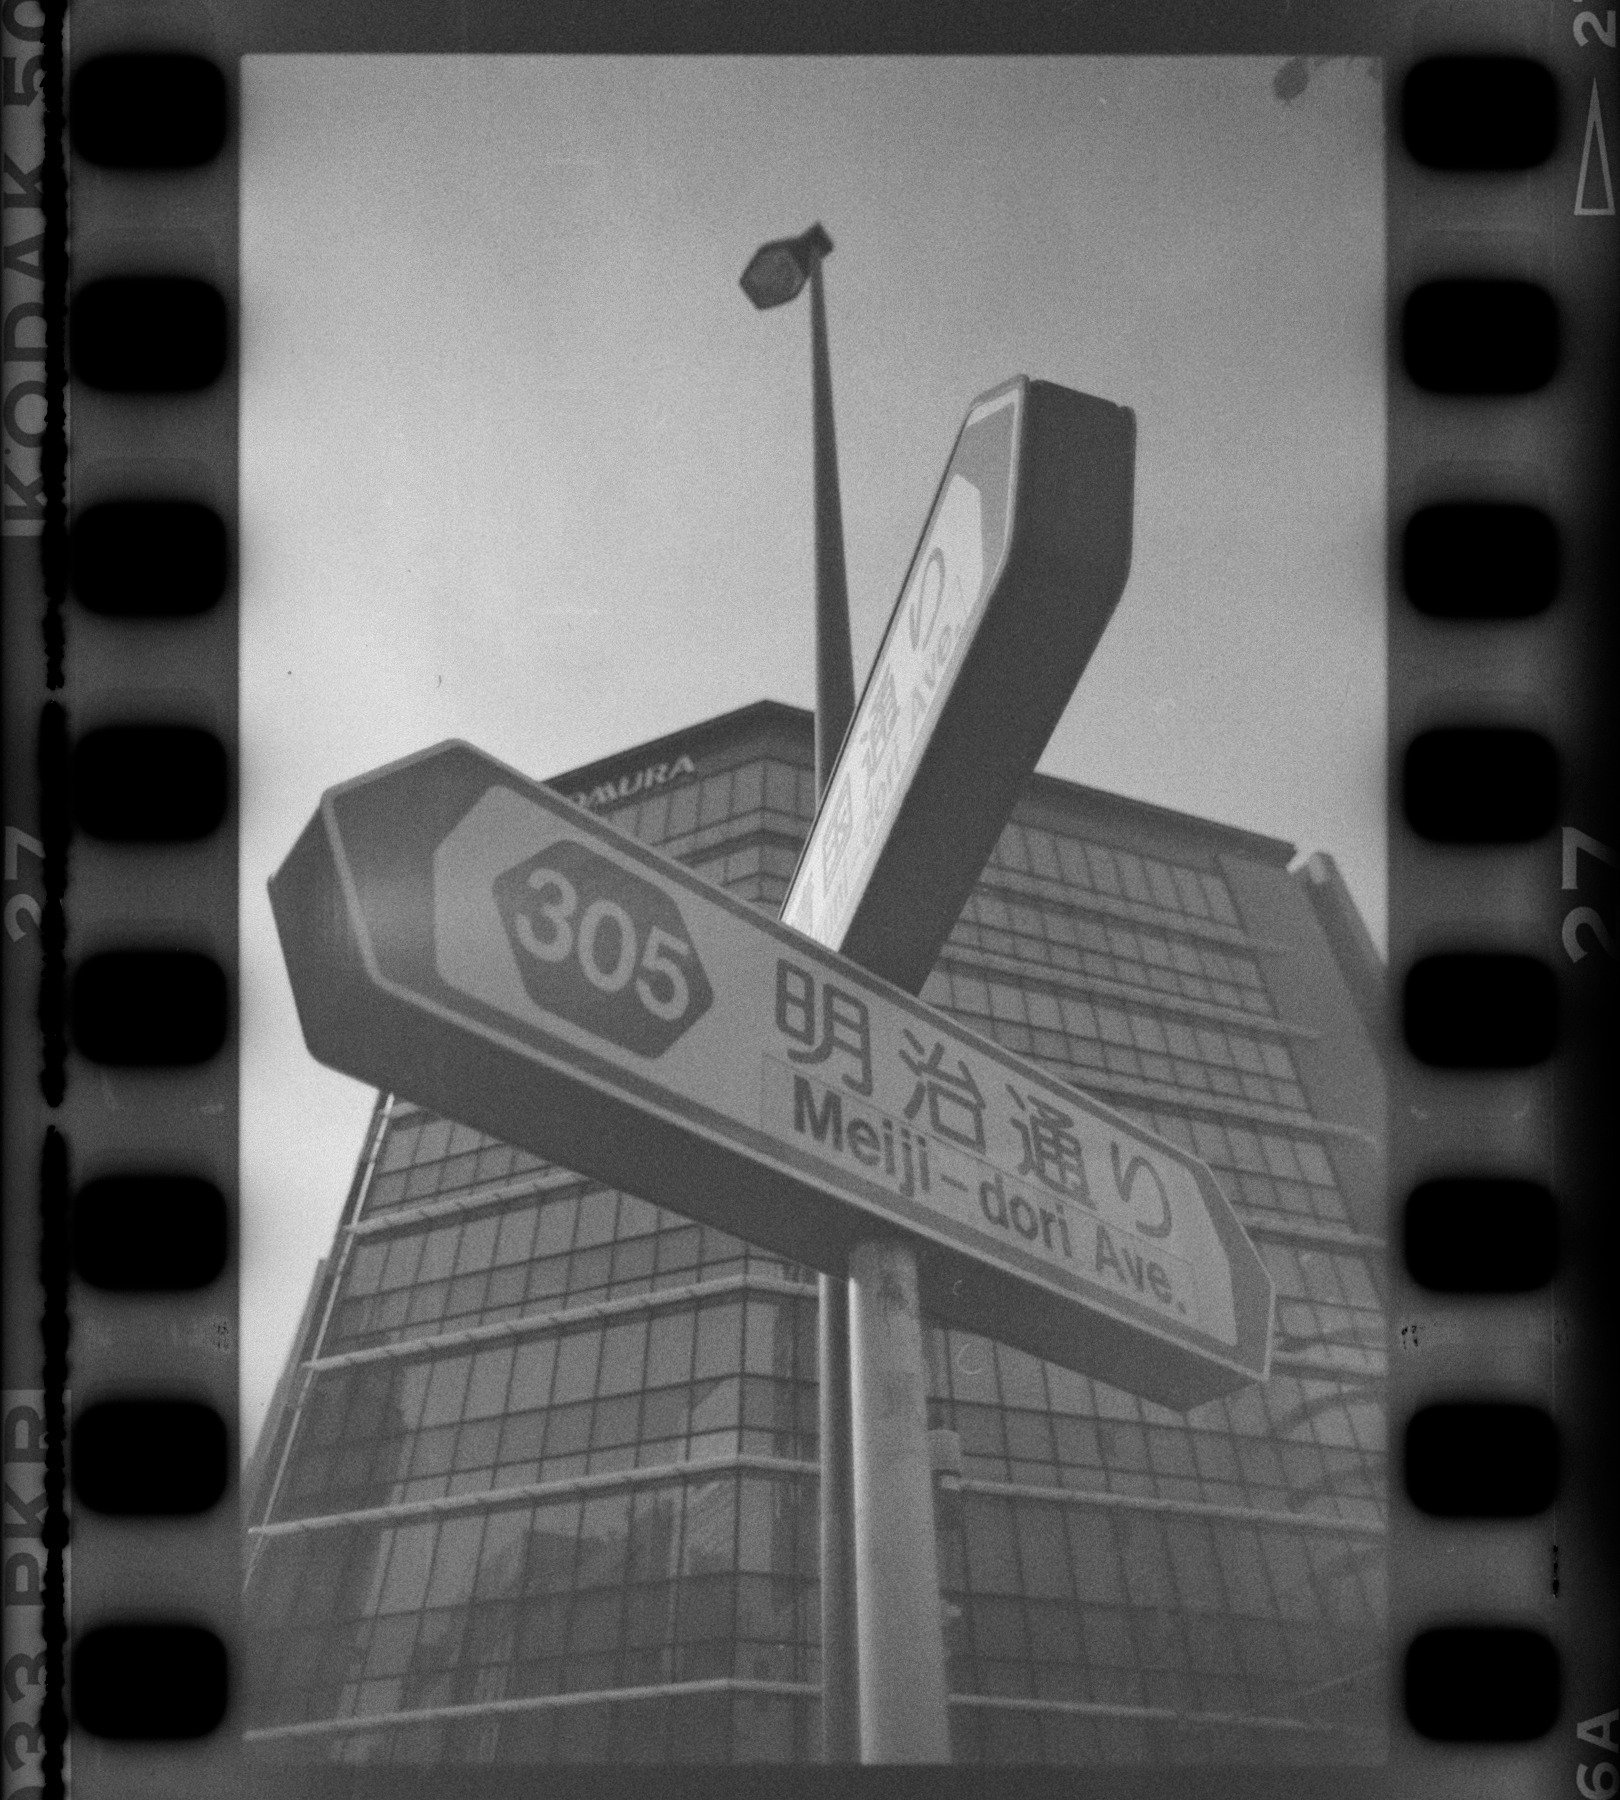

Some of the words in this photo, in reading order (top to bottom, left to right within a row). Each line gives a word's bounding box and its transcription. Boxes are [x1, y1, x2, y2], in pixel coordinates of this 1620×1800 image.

[3, 151, 46, 522] KODAK
[4, 826, 46, 943] 27
[512, 867, 690, 1022] 305
[1561, 827, 1618, 963] 27
[775, 957, 1173, 1239] 明治通り
[793, 1073, 1073, 1259] Meiji-dori
[1096, 1224, 1187, 1315] Ave.
